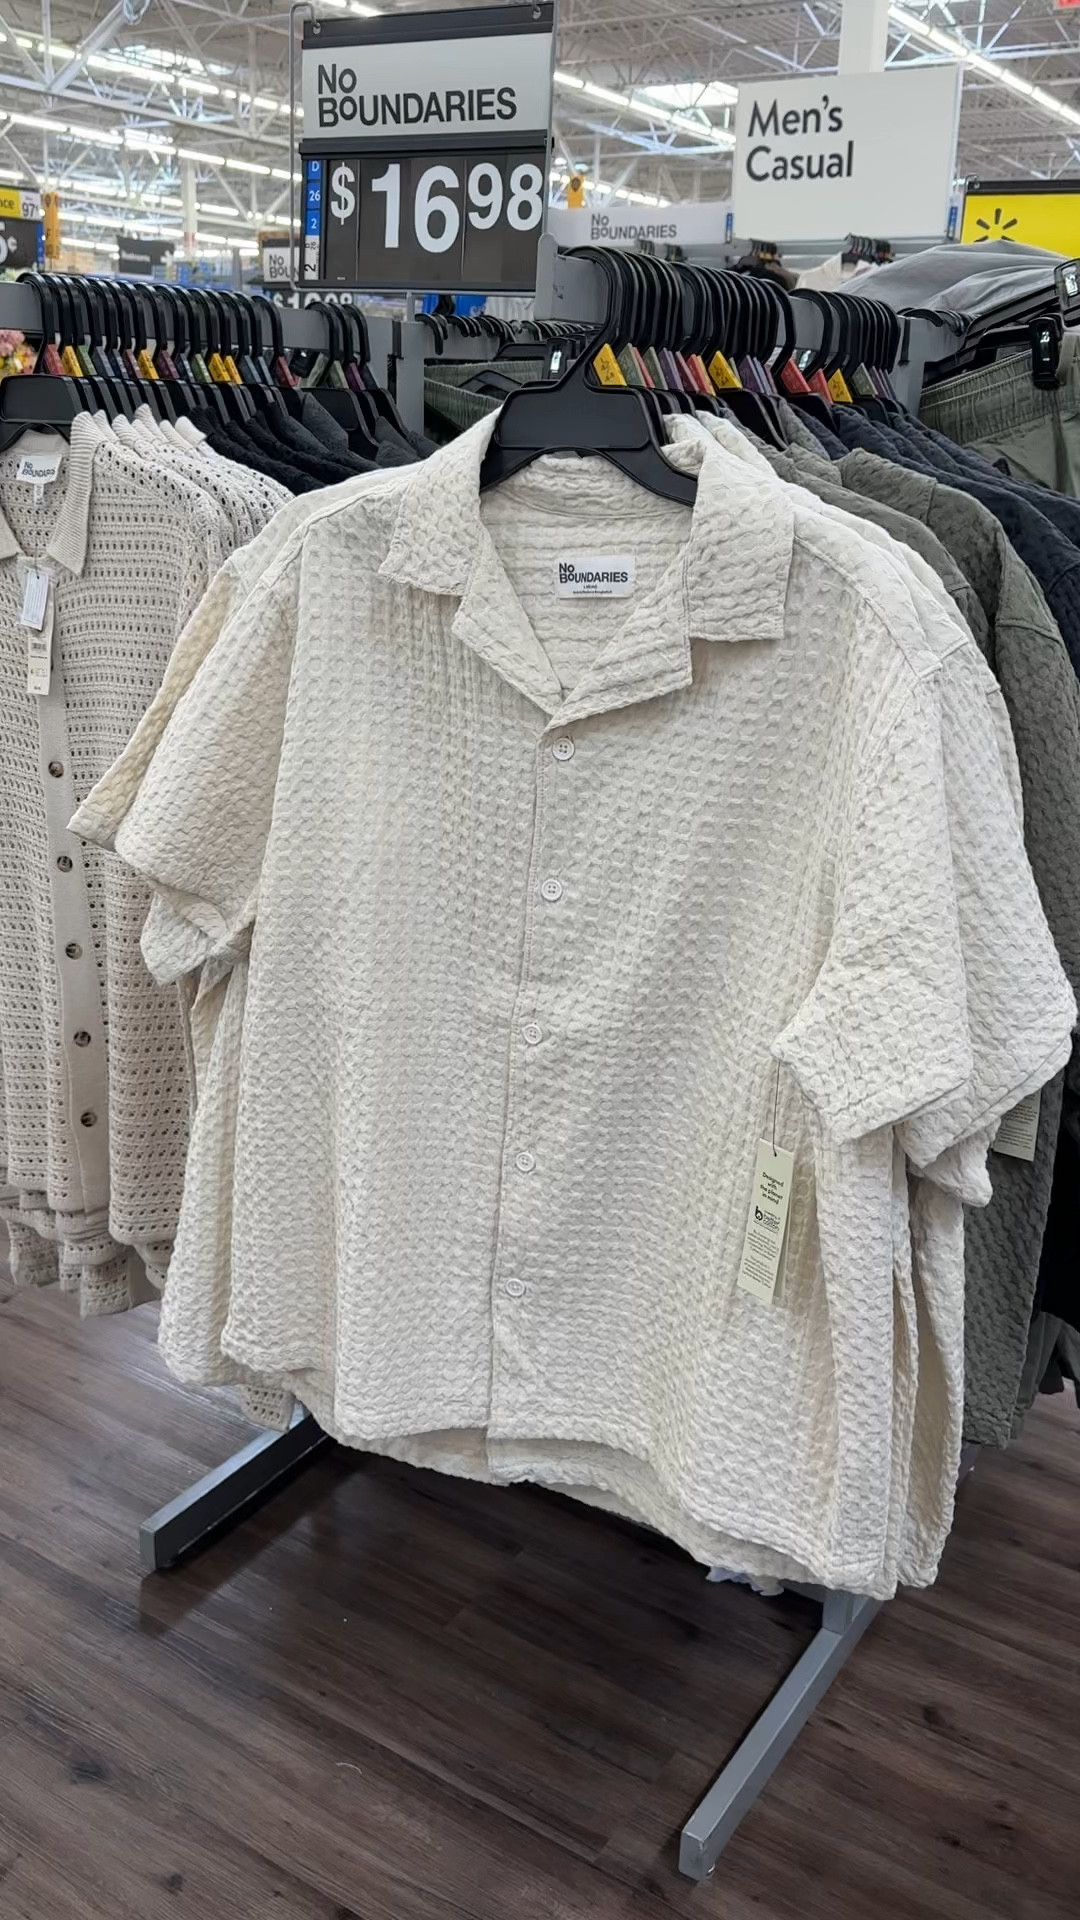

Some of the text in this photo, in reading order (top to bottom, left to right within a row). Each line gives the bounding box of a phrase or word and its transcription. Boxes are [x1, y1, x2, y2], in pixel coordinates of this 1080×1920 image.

[318, 63, 358, 95] No
[318, 86, 518, 127] BOUNDARIES
[747, 94, 844, 137] Men's
[746, 140, 854, 182] Casual
[309, 190, 320, 202] 26
[311, 217, 317, 229] 2
[590, 213, 610, 226] No
[590, 224, 678, 240] BOUNDARIES
[559, 562, 575, 573] No
[559, 571, 629, 584] BOUNDARIES
